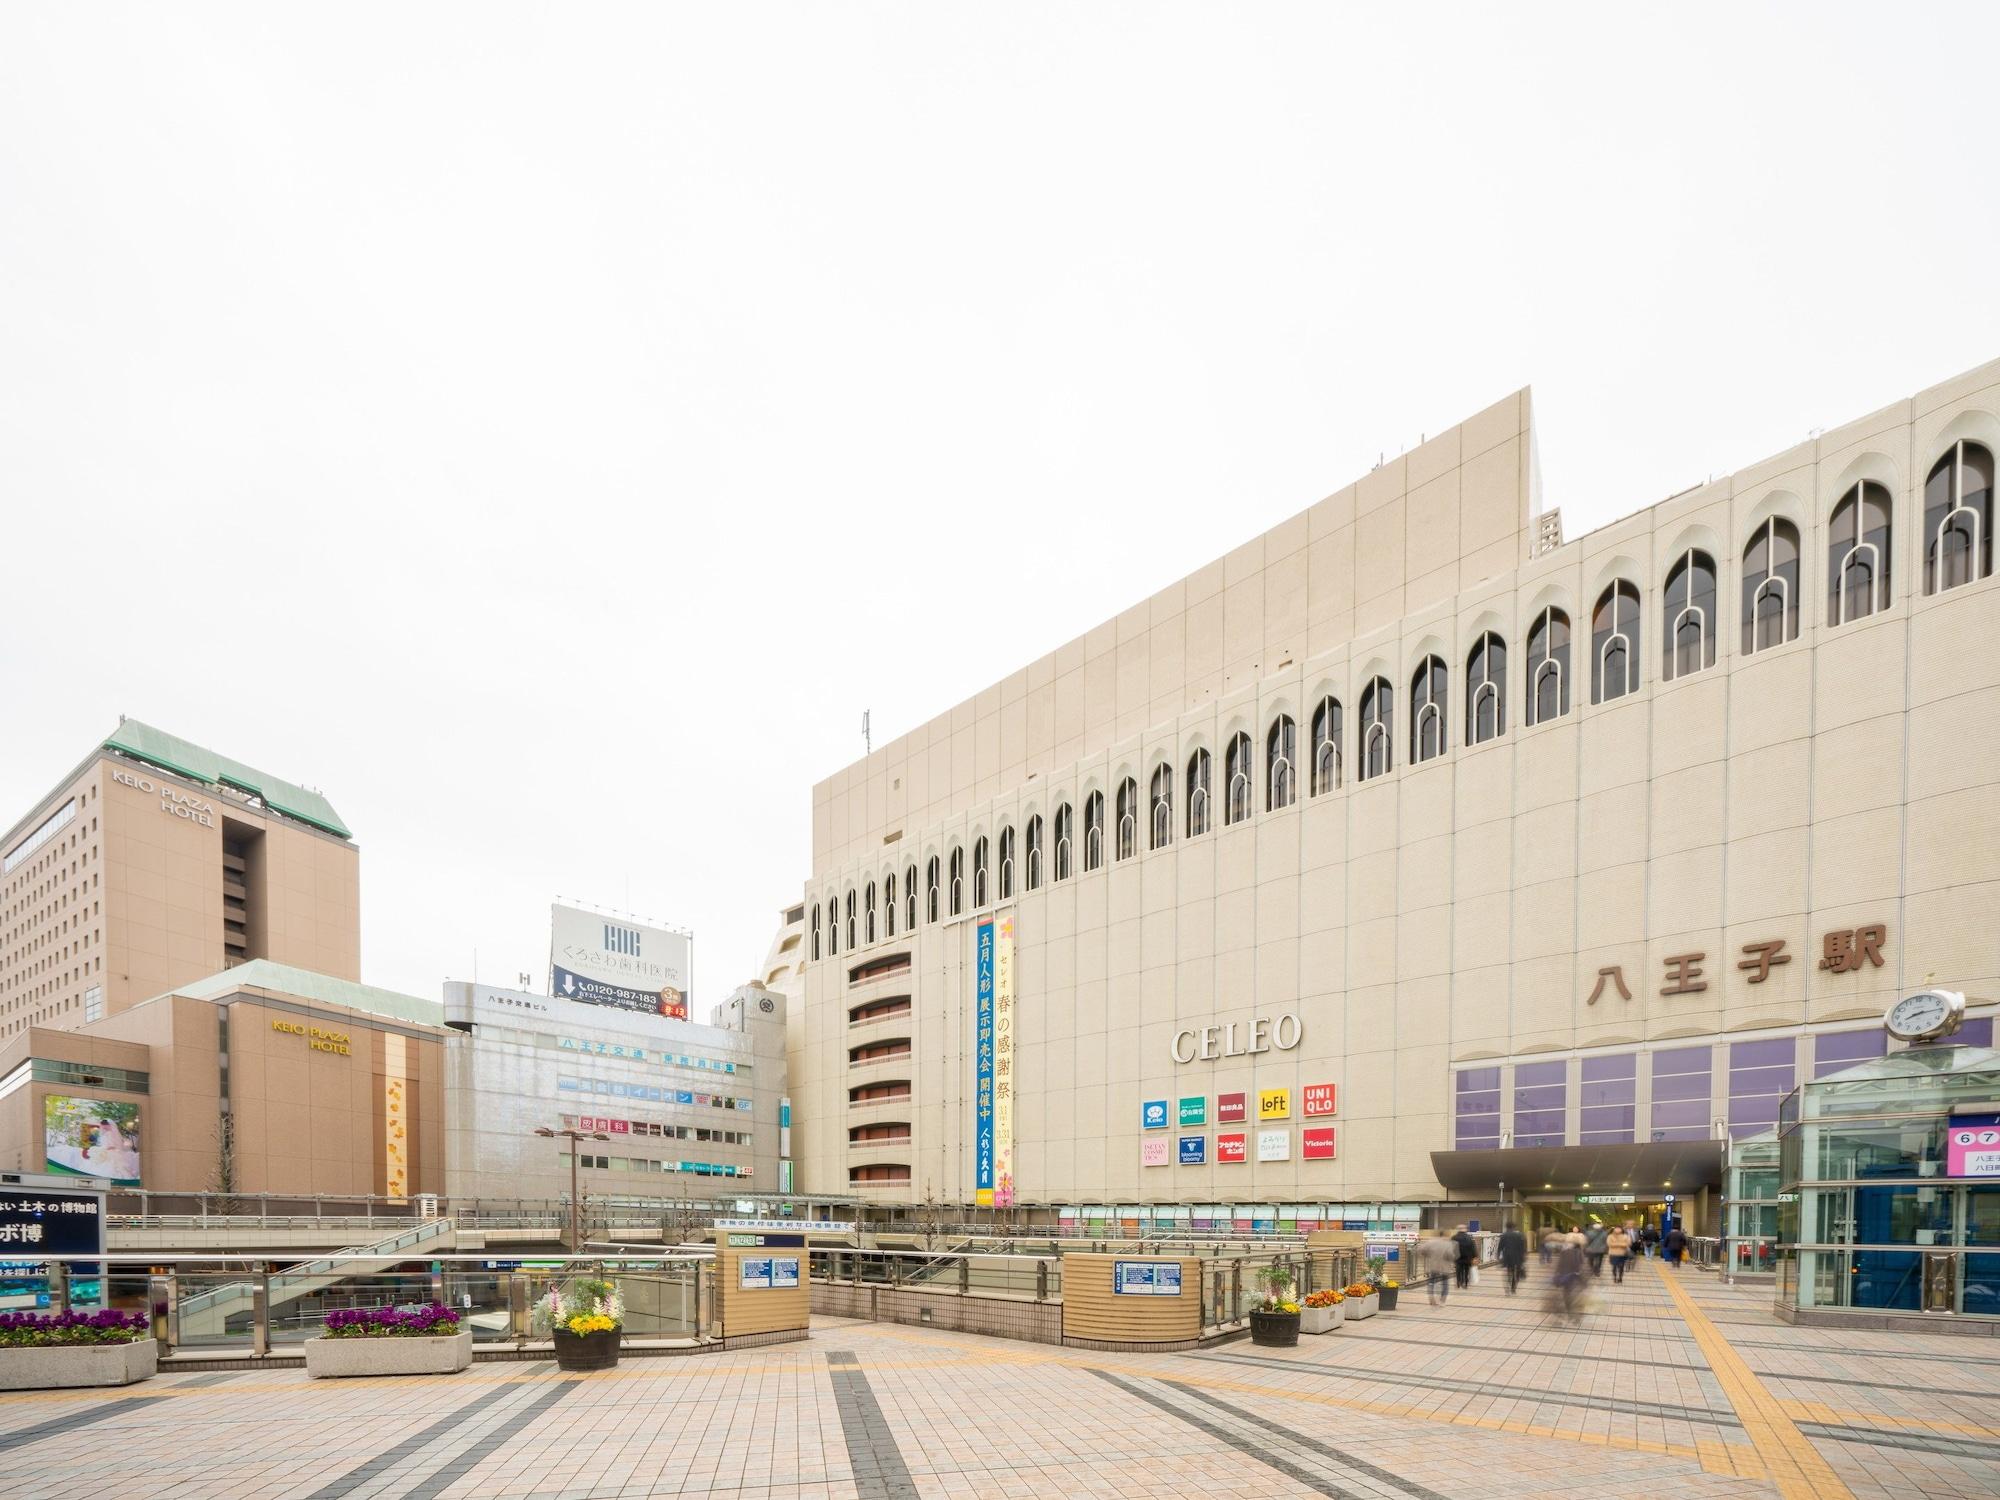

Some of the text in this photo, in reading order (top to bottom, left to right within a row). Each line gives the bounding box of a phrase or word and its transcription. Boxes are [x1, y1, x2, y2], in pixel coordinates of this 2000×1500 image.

[112, 769, 214, 816] KEIO PLAZA
[161, 800, 216, 830] HOTEL
[562, 945, 681, 982] くろさわ歯科医院
[1587, 924, 1887, 1006] 八王子駅
[488, 995, 548, 1012] 八王子交通ビル
[587, 982, 657, 1005] 0120-987-183
[272, 1020, 352, 1044] KEIO PLAZA
[1171, 1014, 1303, 1064] CELEO
[310, 1040, 353, 1056] HOTEL
[562, 1039, 645, 1060] 八王子交通
[1307, 1088, 1330, 1099] UNI
[1307, 1100, 1332, 1112] QLO
[582, 1119, 624, 1131] 皮膚科
[1961, 1133, 1994, 1143] 6 7
